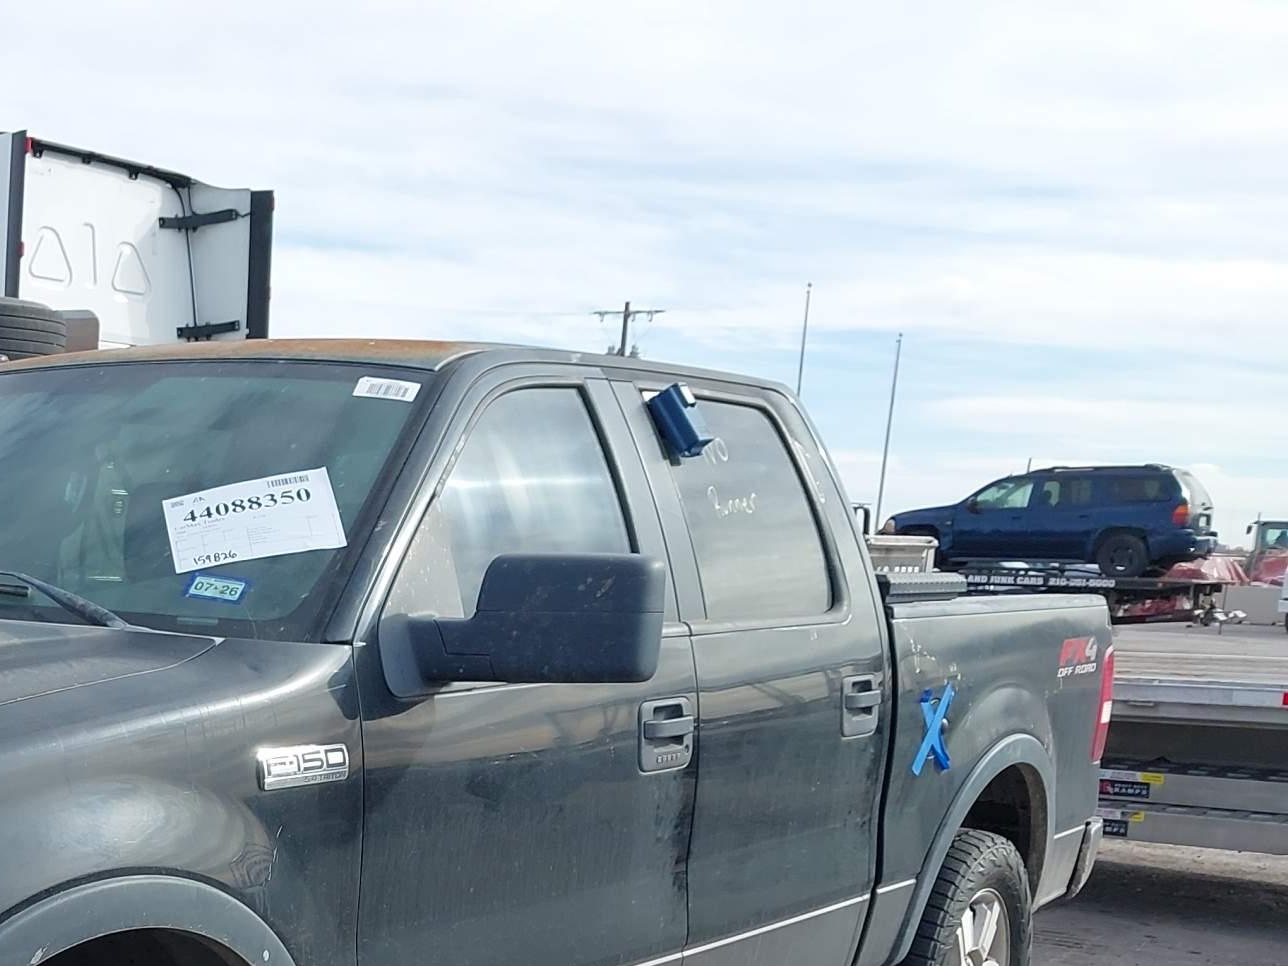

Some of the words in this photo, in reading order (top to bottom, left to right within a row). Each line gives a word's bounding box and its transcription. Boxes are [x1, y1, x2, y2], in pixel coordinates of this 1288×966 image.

[183, 487, 312, 523] 44088350
[194, 581, 214, 593] 07
[219, 584, 240, 596] 26
[1016, 576, 1044, 586] CARS
[1059, 635, 1098, 667] FX4
[1056, 666, 1075, 678] OFF
[1074, 662, 1098, 675] ROAD
